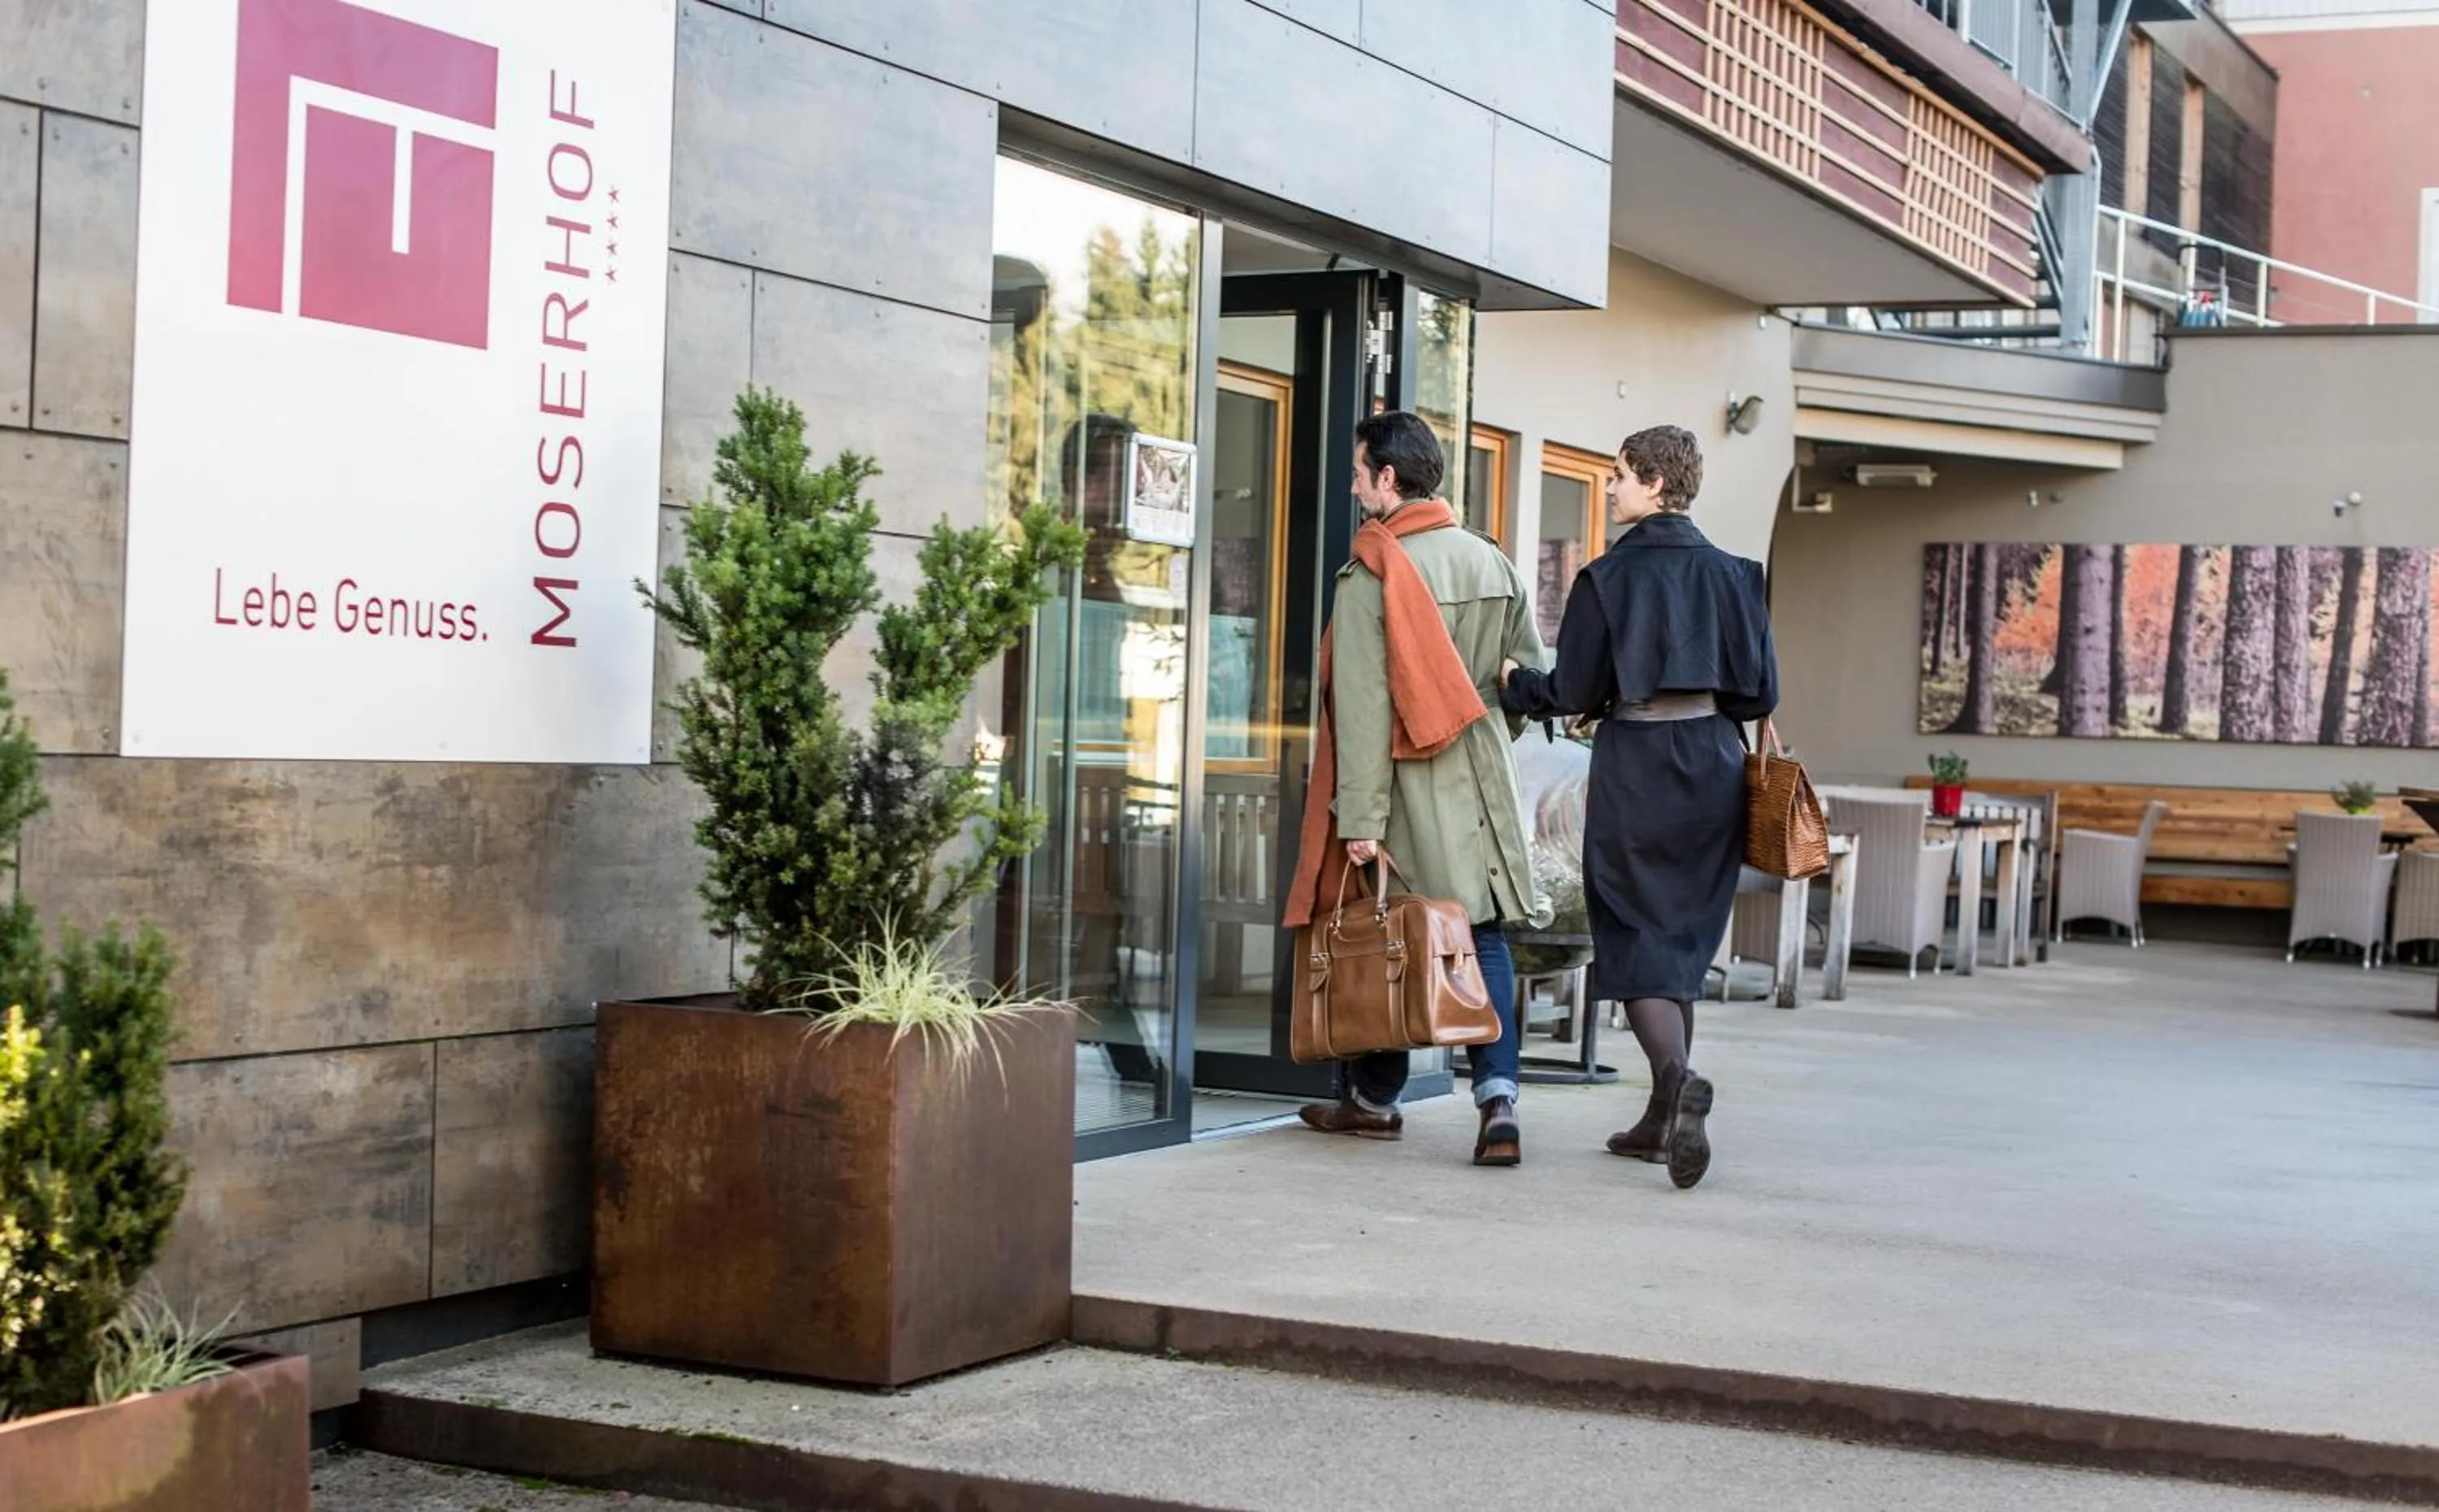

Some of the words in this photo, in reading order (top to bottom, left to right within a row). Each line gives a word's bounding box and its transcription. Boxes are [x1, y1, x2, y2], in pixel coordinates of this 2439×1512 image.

[531, 68, 595, 648] MOSERHOF
[214, 567, 316, 631] Lebe
[334, 577, 489, 641] Genuss.
